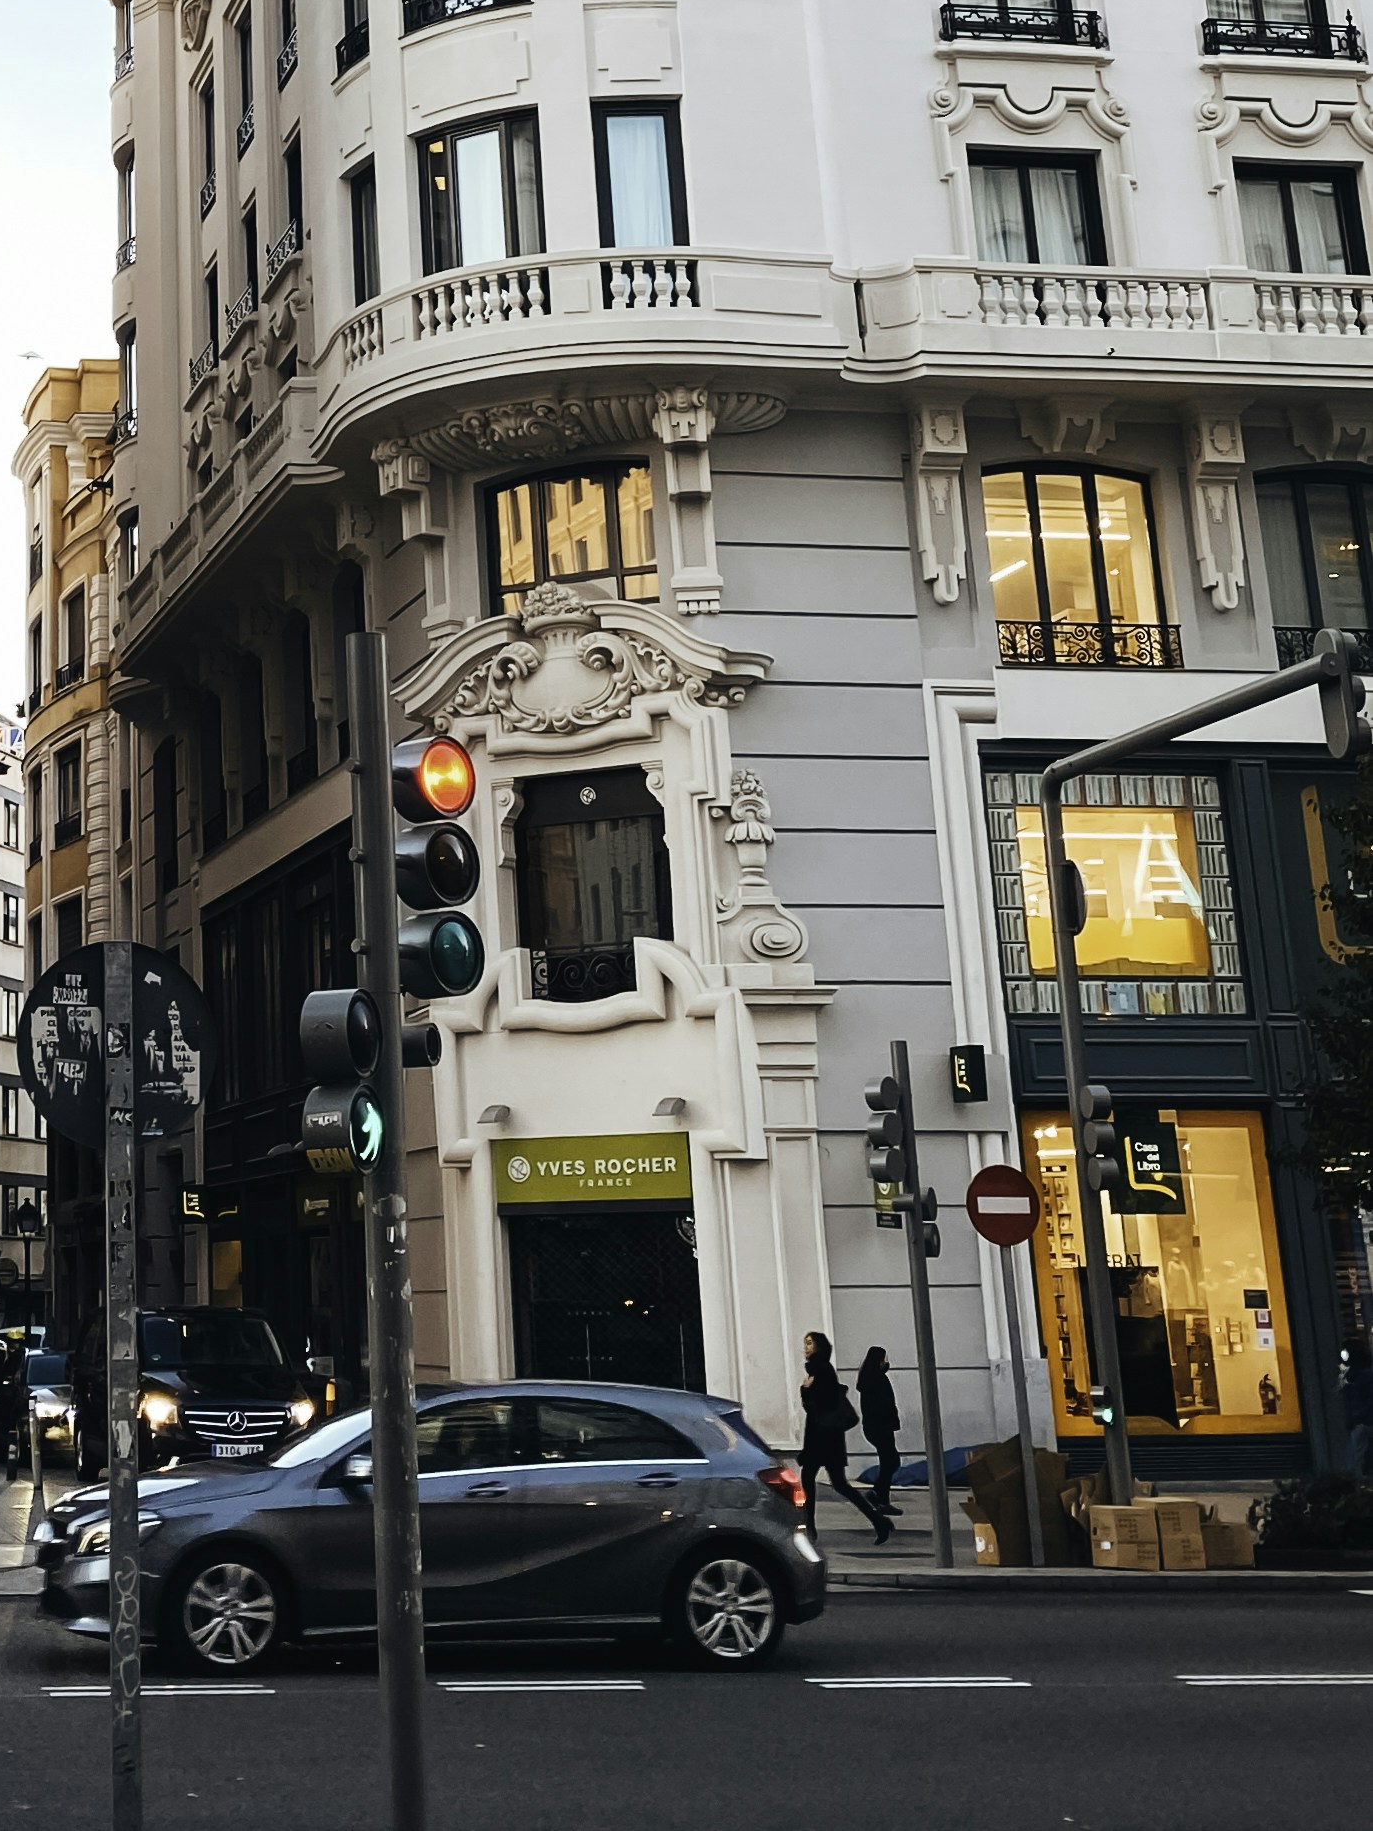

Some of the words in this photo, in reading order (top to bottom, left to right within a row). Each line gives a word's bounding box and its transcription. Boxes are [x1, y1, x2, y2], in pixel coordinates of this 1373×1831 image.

[1134, 1142, 1159, 1152] Casa
[1146, 1153, 1160, 1161] del
[537, 1159, 586, 1176] YVES
[594, 1157, 677, 1175] ROCHER
[1137, 1161, 1161, 1171] Libro
[579, 1178, 632, 1188] FRANCE
